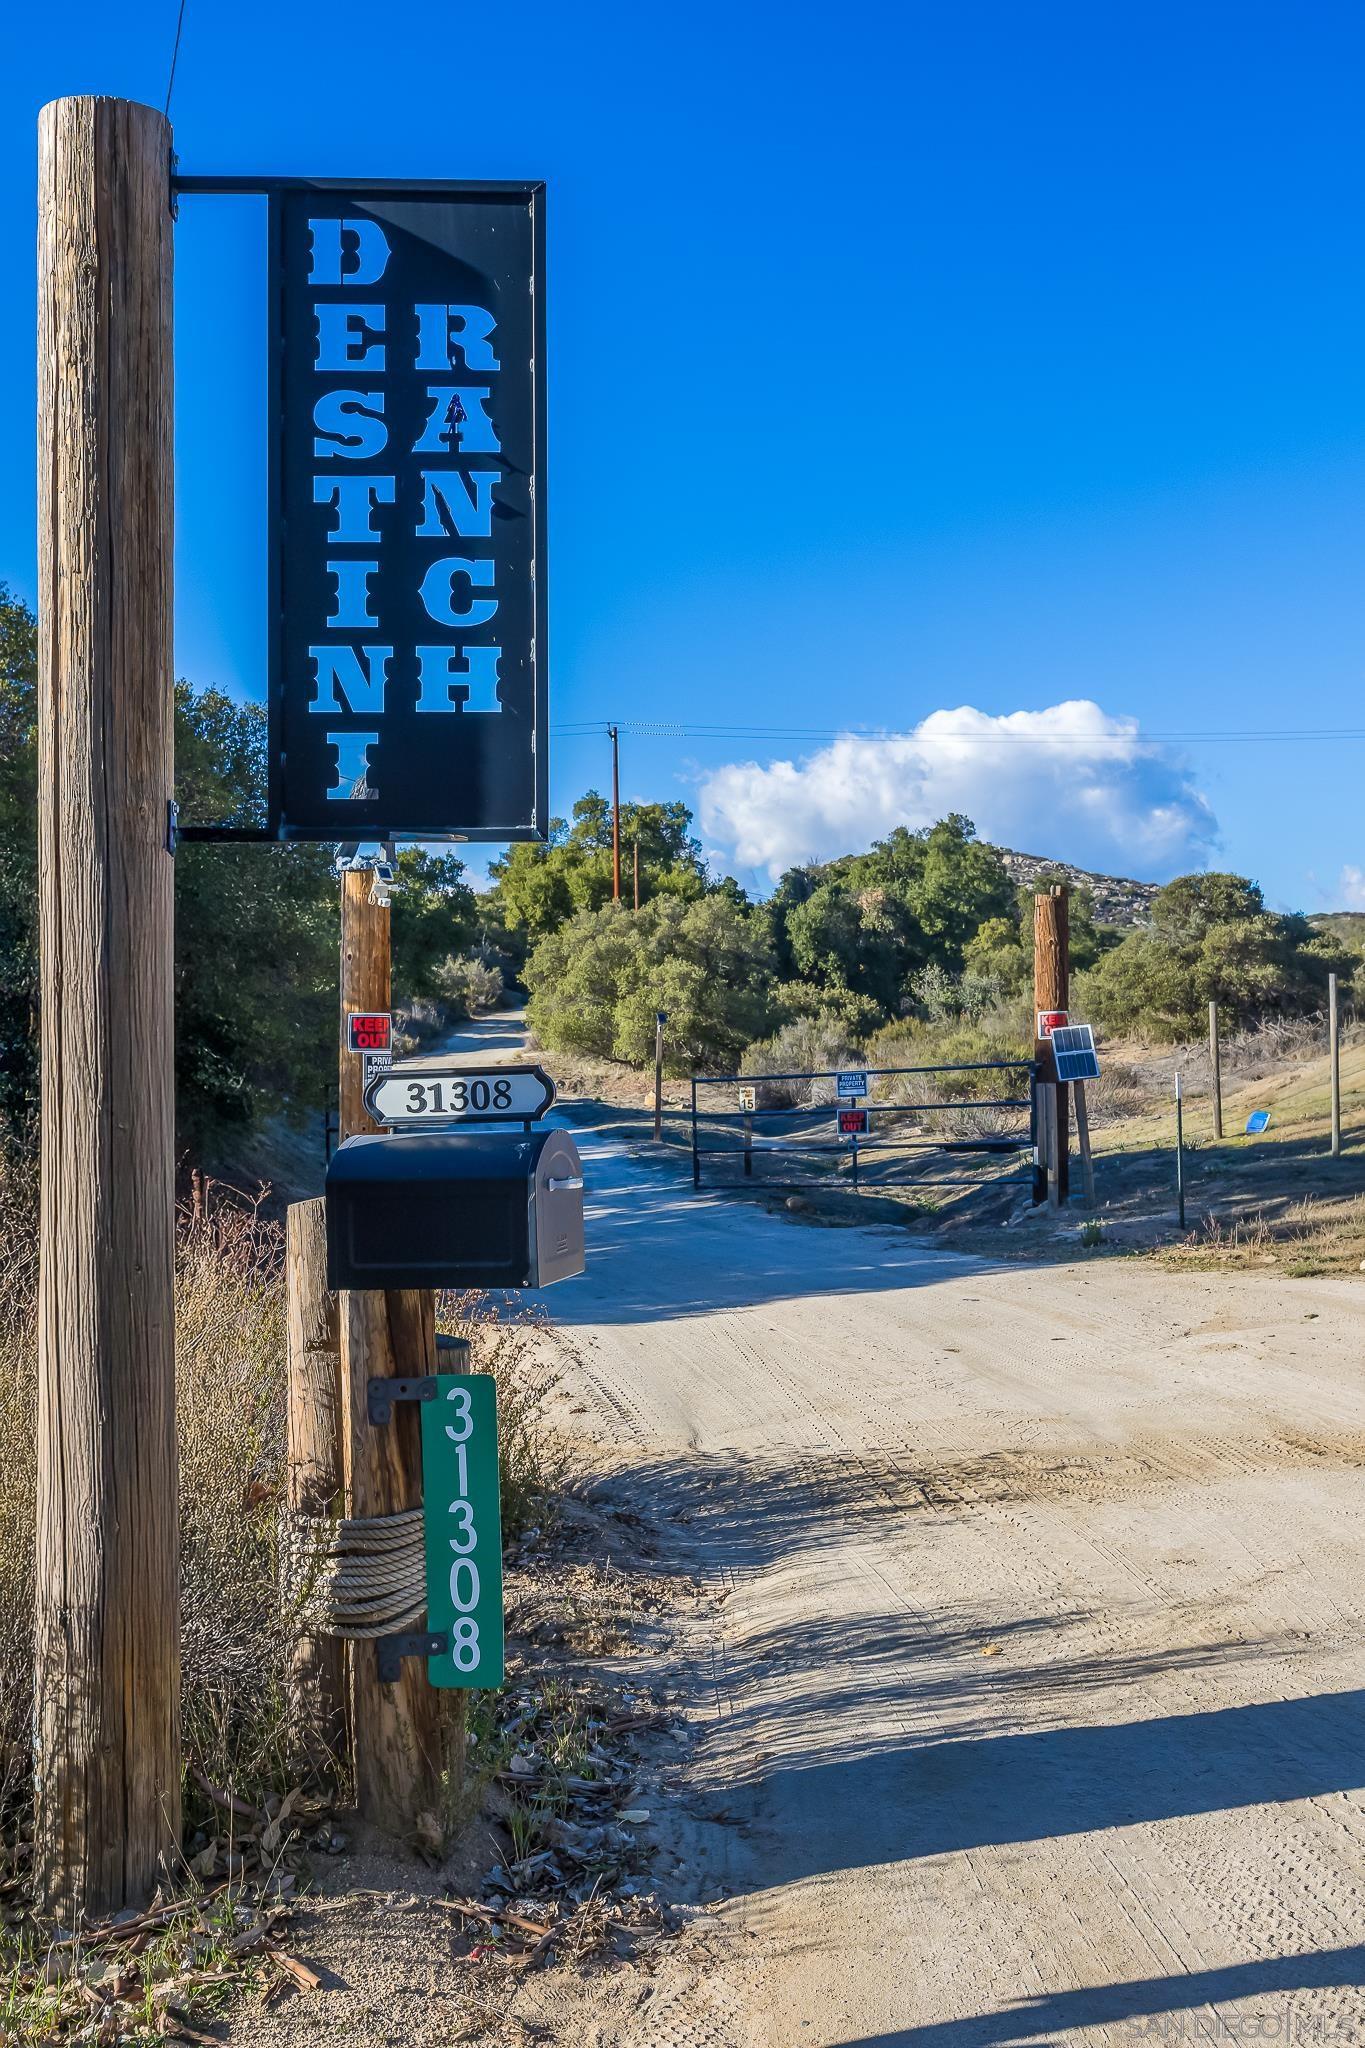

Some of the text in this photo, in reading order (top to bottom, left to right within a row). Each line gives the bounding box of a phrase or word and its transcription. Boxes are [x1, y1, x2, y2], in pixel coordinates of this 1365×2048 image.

[307, 217, 395, 800] DESTINI
[411, 303, 502, 713] RANCH
[357, 1033, 388, 1048] OUT
[406, 1079, 513, 1114] 31308
[741, 1099, 753, 1109] 15
[840, 1112, 865, 1121] KEEP
[843, 1122, 863, 1131] OUT
[445, 1387, 481, 1672] 31308
